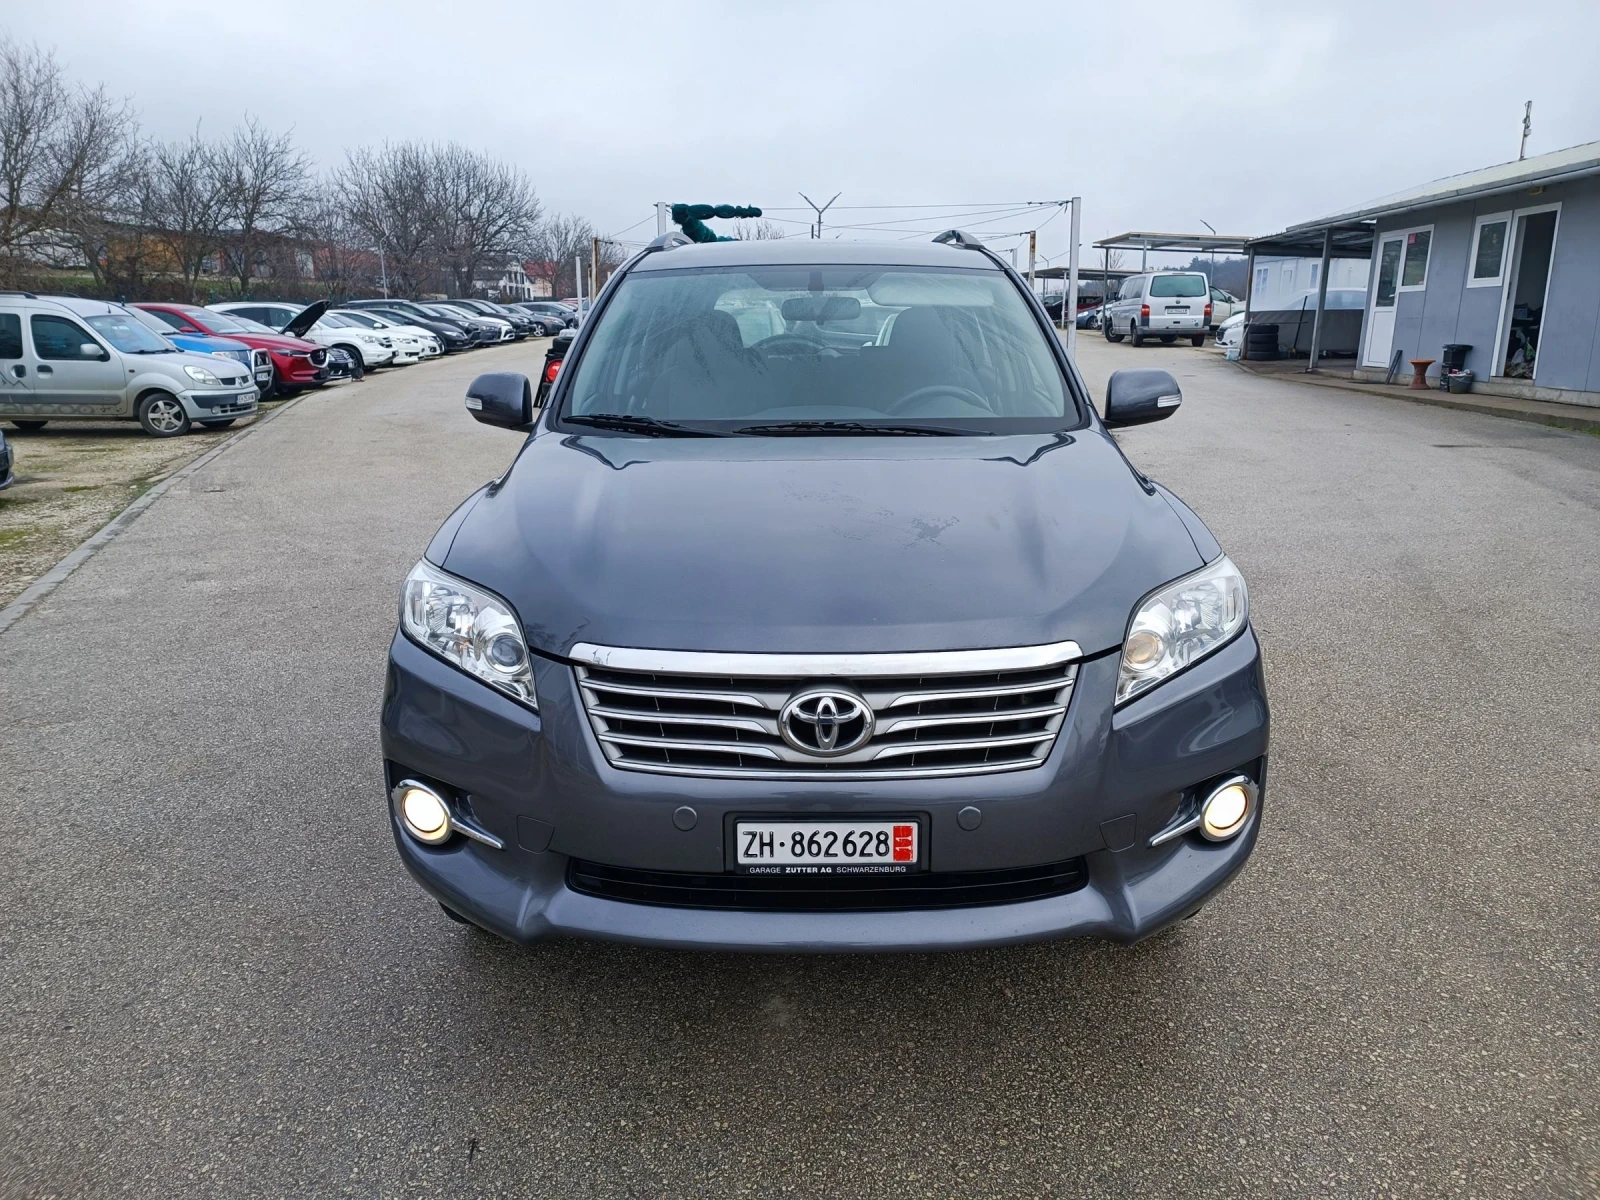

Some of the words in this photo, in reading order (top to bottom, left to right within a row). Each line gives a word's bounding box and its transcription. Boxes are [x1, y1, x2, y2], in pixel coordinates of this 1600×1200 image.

[749, 866, 782, 874] GARAGE
[785, 866, 818, 874] ZUTTER
[836, 865, 907, 873] SCHWARZENBURG
